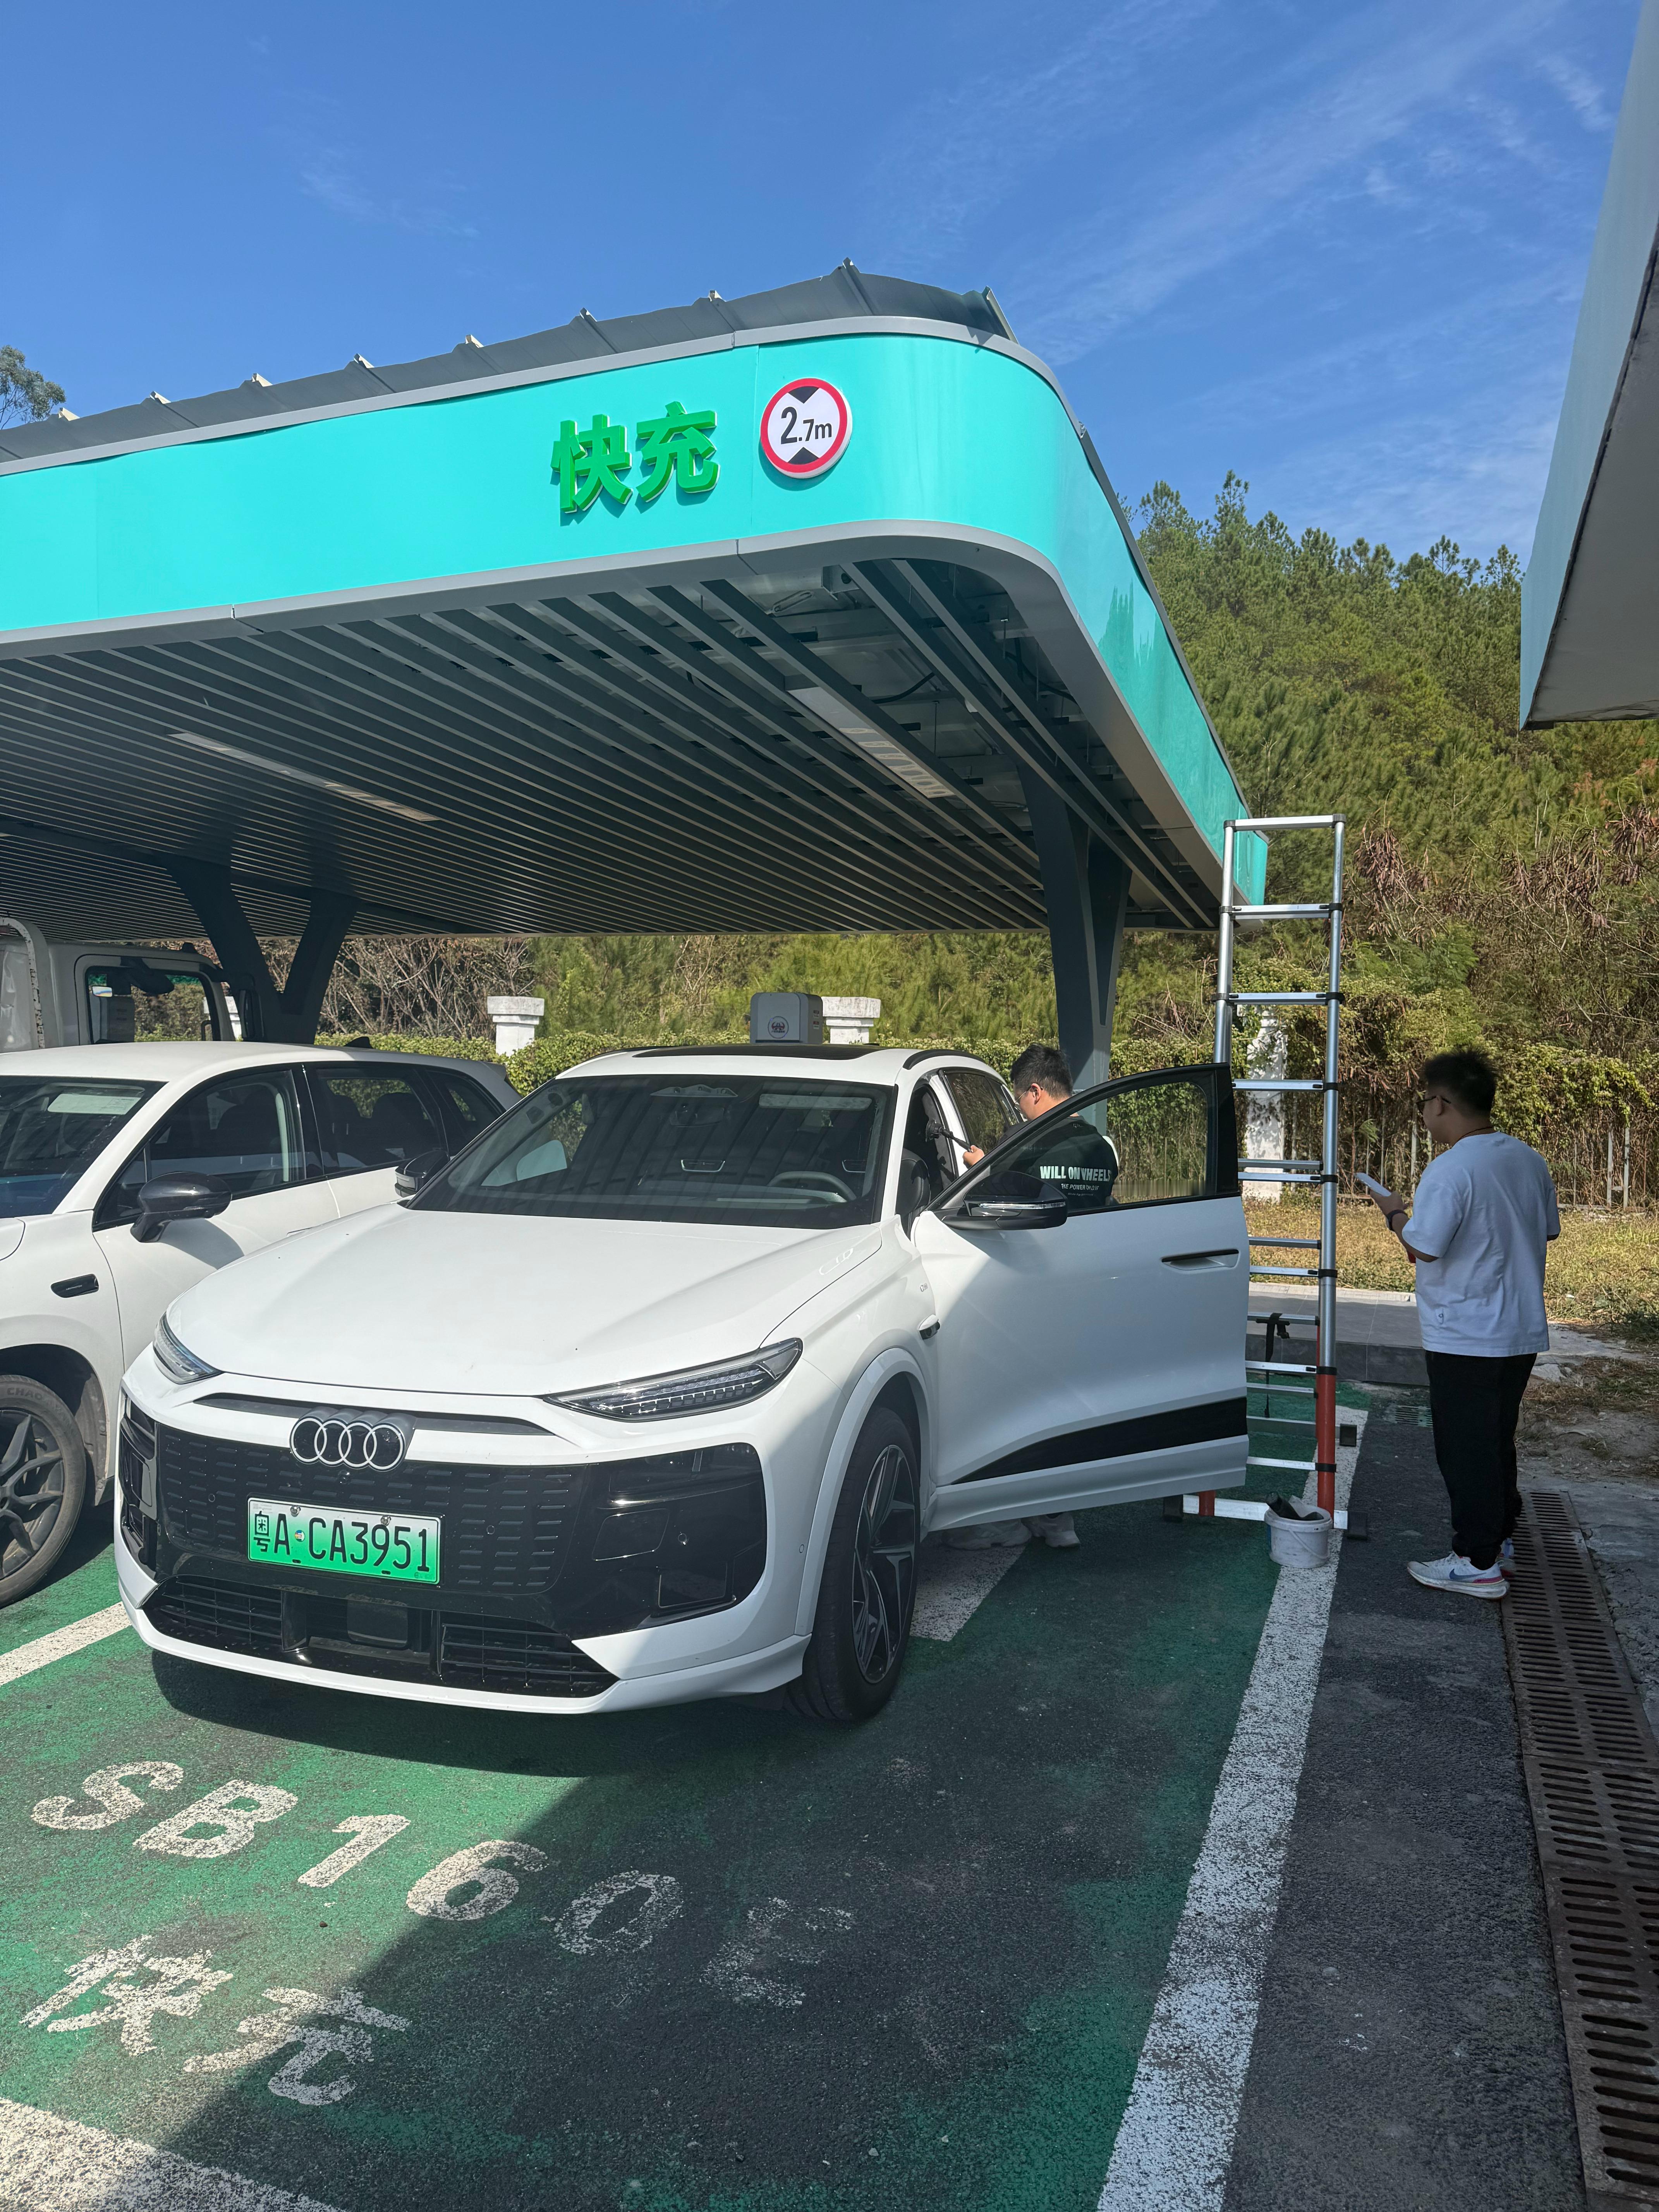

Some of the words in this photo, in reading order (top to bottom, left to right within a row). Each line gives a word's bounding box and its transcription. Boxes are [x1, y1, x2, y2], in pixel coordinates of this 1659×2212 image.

[551, 401, 720, 514] 快充
[780, 406, 833, 444] 2.7m
[1040, 1166, 1066, 1179] WILL
[1068, 1166, 1080, 1180] ON
[19, 1935, 412, 2106] 快充
